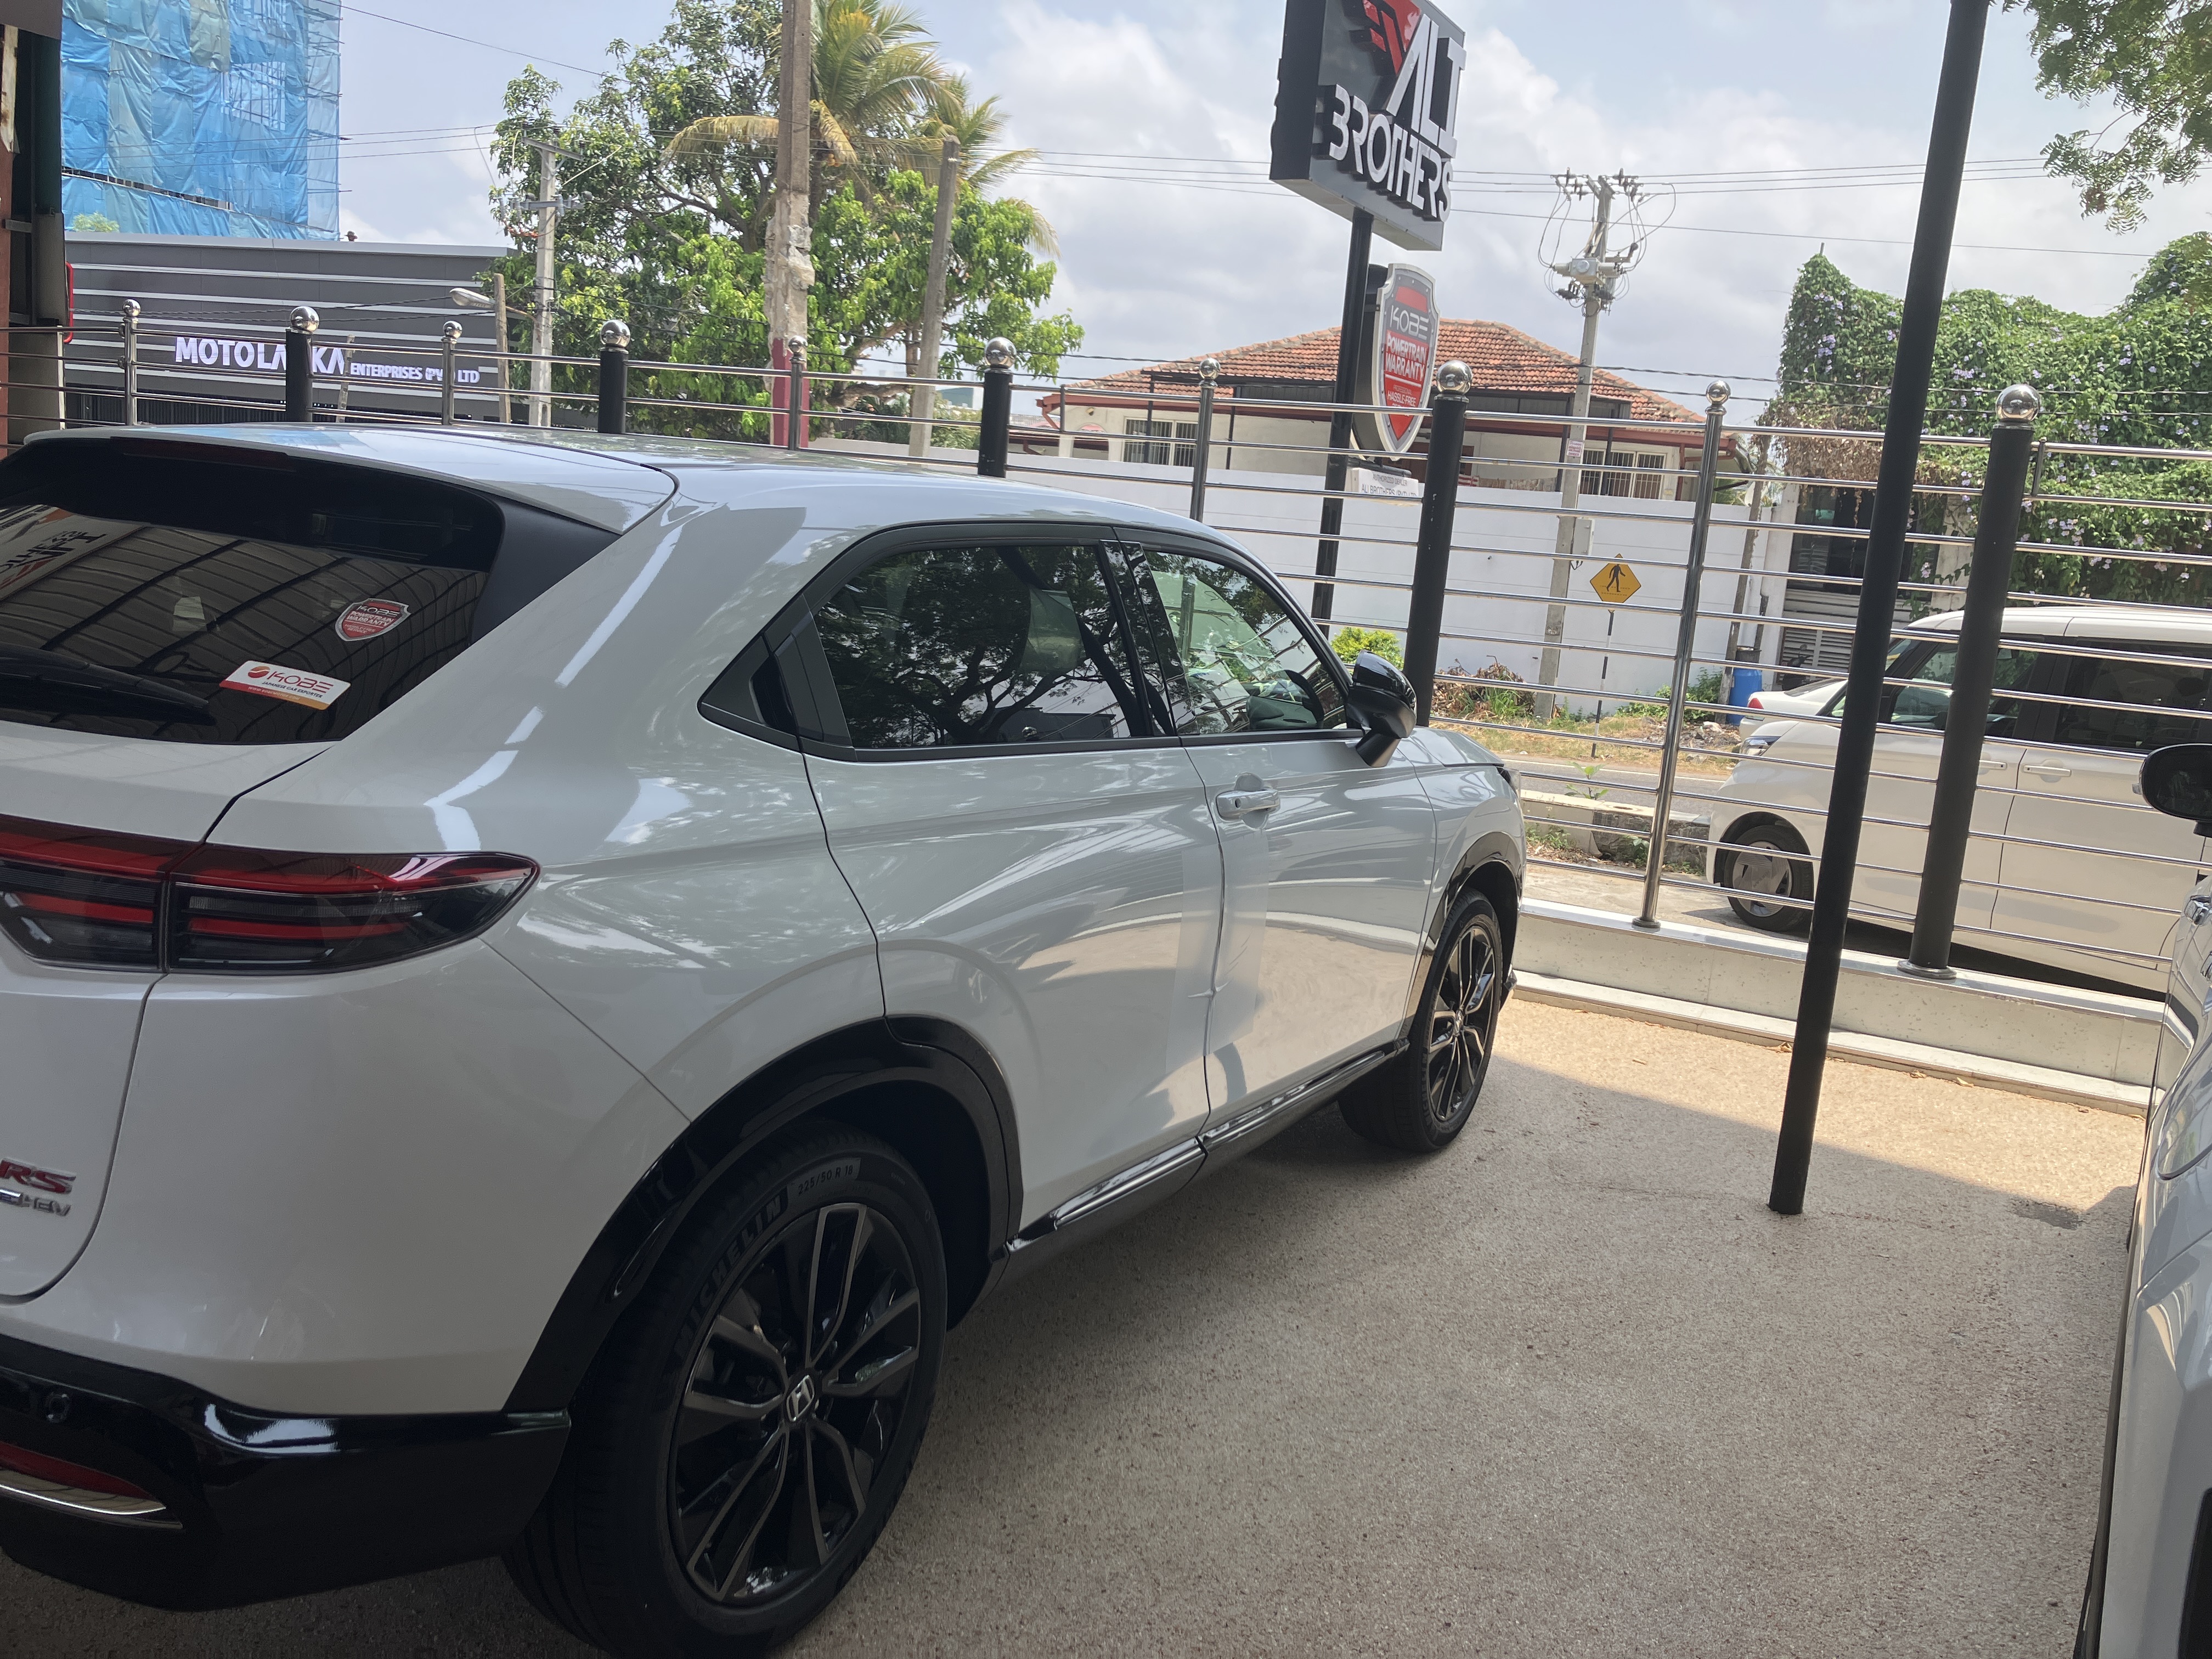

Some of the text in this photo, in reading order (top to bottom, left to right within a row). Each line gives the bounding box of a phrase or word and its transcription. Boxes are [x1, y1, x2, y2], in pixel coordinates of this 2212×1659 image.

[1386, 13, 1467, 159] ALI
[1329, 84, 1454, 223] BROTHERS
[1390, 305, 1429, 341] KOBE
[176, 336, 345, 375] MOTOLAKA
[351, 362, 423, 380] ENTERPRISES
[458, 369, 480, 383] LTD
[1386, 334, 1427, 364] POWERTRAIN
[1385, 352, 1425, 382] WARRANTY
[1361, 483, 1369, 493] ALI
[1373, 473, 1408, 487] AUTHORIZED DEALER
[347, 615, 390, 627] WARRANTY
[351, 611, 394, 623] POWERTRAIN
[357, 605, 400, 618] KOBE
[262, 681, 287, 689] JAPANESE
[297, 689, 323, 698] EXPORTER
[267, 671, 334, 693] KOBE
[0, 1158, 76, 1194] RS
[798, 1170, 832, 1195] 225/50
[835, 1167, 841, 1177] R
[845, 1164, 854, 1176] 18
[674, 1195, 782, 1358] MICHELIN
